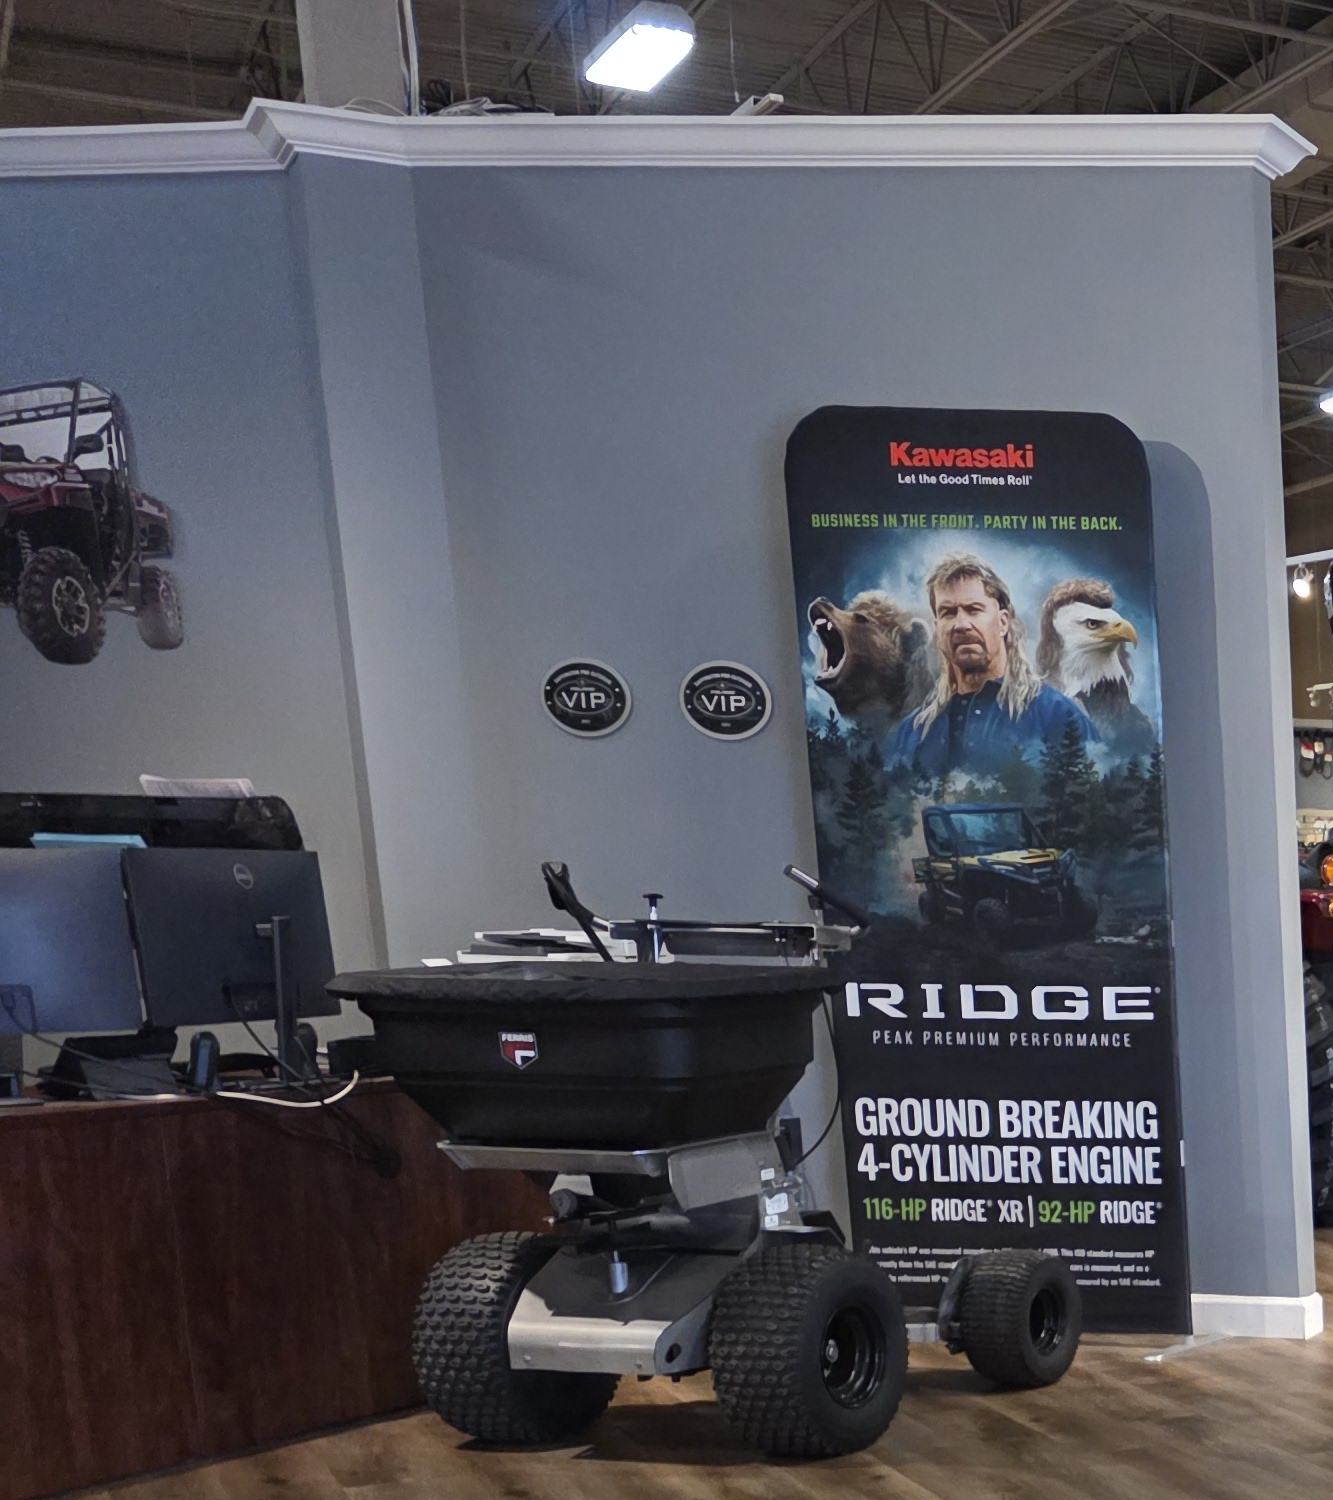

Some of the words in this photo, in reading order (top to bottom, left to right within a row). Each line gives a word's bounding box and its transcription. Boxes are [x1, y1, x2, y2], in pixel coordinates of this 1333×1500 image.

[889, 441, 1034, 469] Kawasaki
[897, 473, 916, 485] Let
[918, 473, 938, 485] the
[938, 474, 969, 485] Good
[971, 475, 1005, 486] Times
[1006, 475, 1031, 486] Roll
[811, 513, 879, 528] BUSINESS
[883, 514, 898, 528] IN
[902, 514, 928, 529] THE
[931, 514, 980, 529] FRONT.
[983, 515, 1028, 530] PARTY
[1032, 516, 1047, 530] IN
[1050, 516, 1077, 531] THE
[1080, 516, 1123, 531] BACK.
[561, 691, 606, 709] VIP
[700, 694, 746, 712] VIP
[845, 982, 1155, 1021] RIDGE
[872, 1030, 913, 1046] PEAK
[923, 1031, 999, 1047] PREMIUM
[1010, 1032, 1132, 1048] PERFORMANCE
[854, 1097, 990, 1138] GROUND
[1000, 1100, 1158, 1140] BREAKING
[857, 1143, 1043, 1184] 4-CYLINDER
[1051, 1146, 1163, 1185] ENGINE
[862, 1197, 927, 1221] 116-HP
[931, 1198, 988, 1223] RIDGE
[998, 1200, 1024, 1223] XR
[1038, 1201, 1096, 1225] 92-HP
[1099, 1202, 1157, 1225] RIDGE
